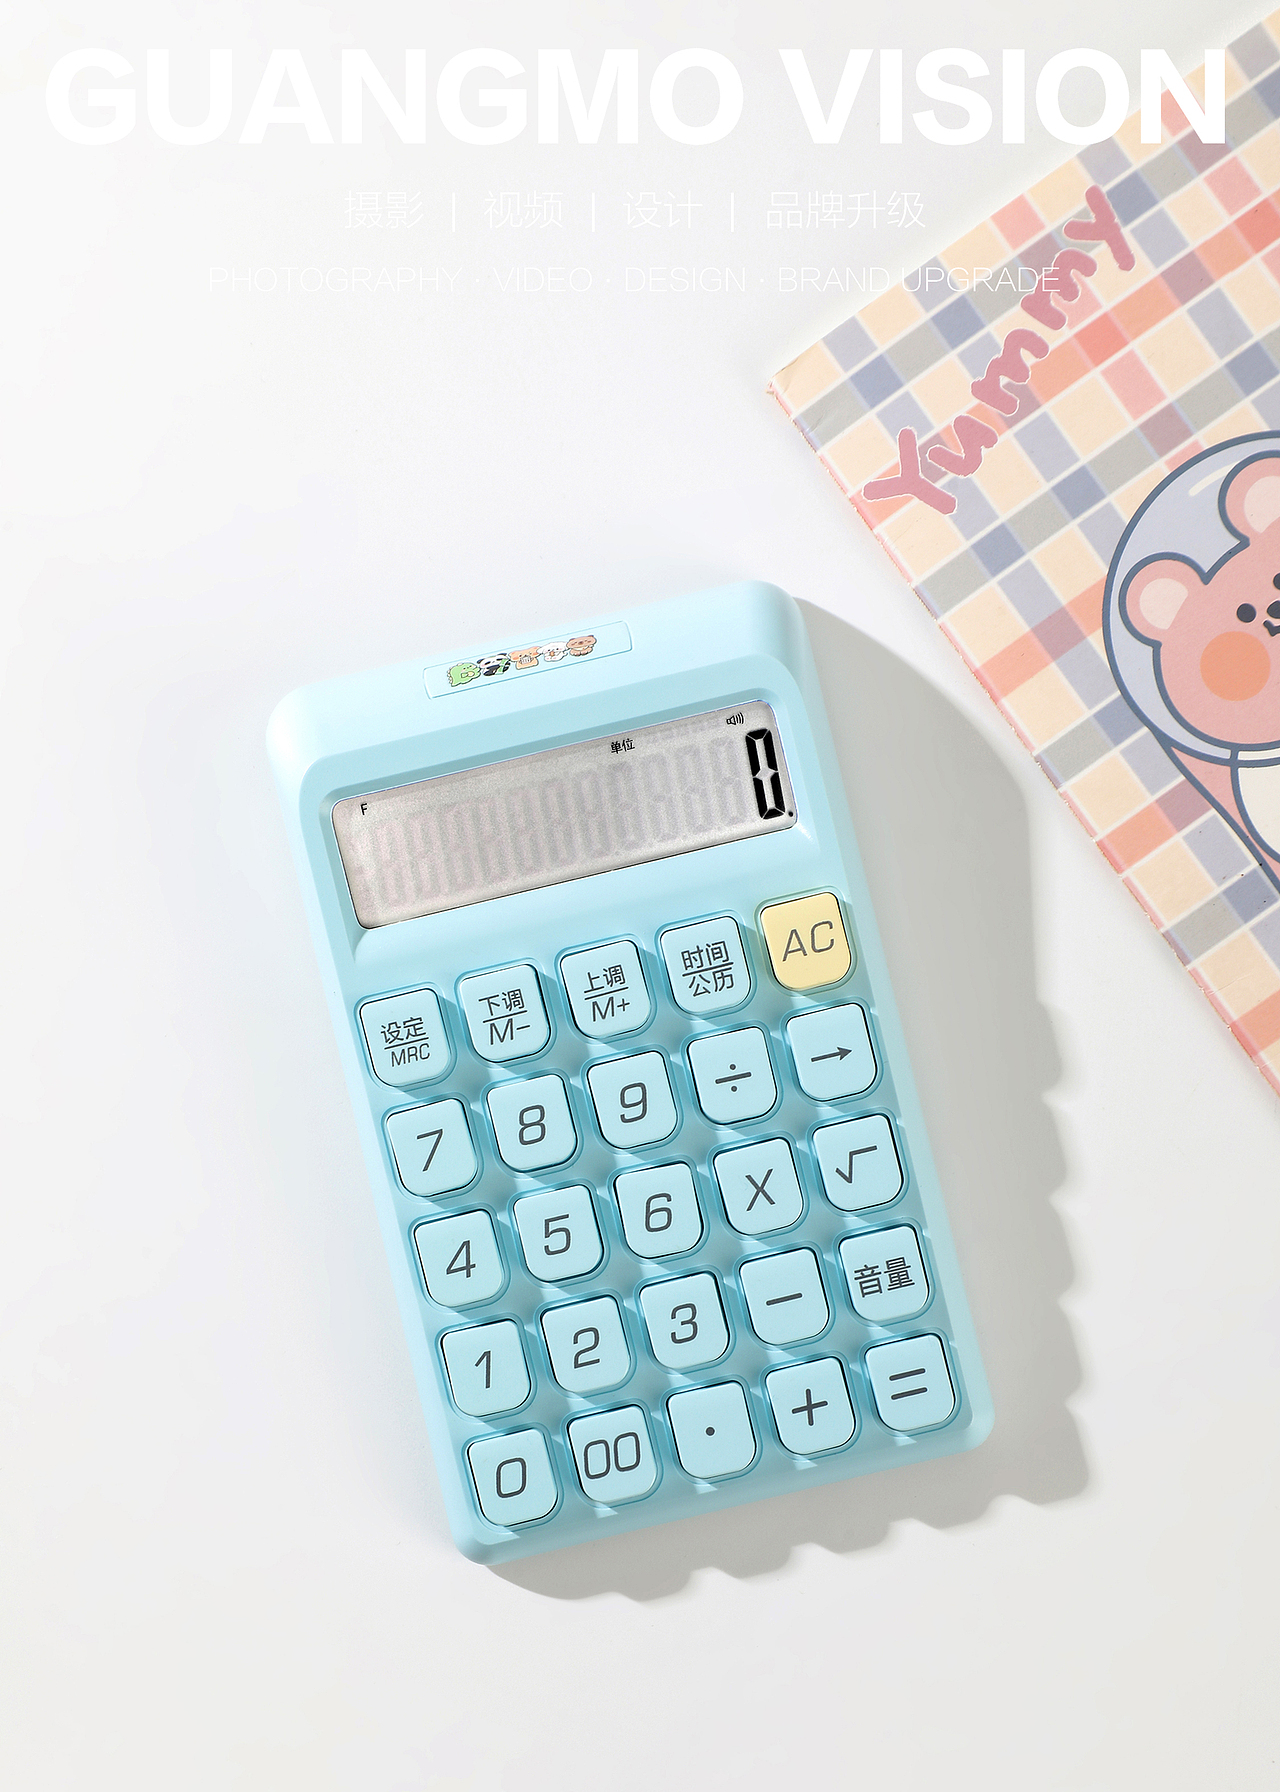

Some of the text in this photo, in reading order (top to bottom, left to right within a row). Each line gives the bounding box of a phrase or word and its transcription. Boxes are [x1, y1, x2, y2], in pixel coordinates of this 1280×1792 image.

[861, 184, 1136, 516] Yummy
[610, 737, 636, 755] 单位
[360, 802, 368, 816] F
[681, 940, 731, 971] 时间
[783, 920, 836, 962] AC
[583, 964, 626, 995] 上调
[687, 968, 735, 998] 公历
[478, 988, 526, 1015] 下调
[591, 994, 631, 1023] M+
[380, 1016, 424, 1044] 设定
[390, 1042, 431, 1068] MRC
[620, 1082, 648, 1124] 9
[518, 1104, 546, 1146] 8
[416, 1128, 443, 1172] 7
[644, 1192, 673, 1233] 6
[544, 1213, 571, 1256] 5
[445, 1239, 476, 1279] 4
[853, 1256, 916, 1297] 音量
[670, 1303, 698, 1344] 3
[573, 1327, 600, 1369] 2
[474, 1350, 491, 1389] 1
[582, 1431, 641, 1479] 00
[495, 1457, 527, 1499] 0
